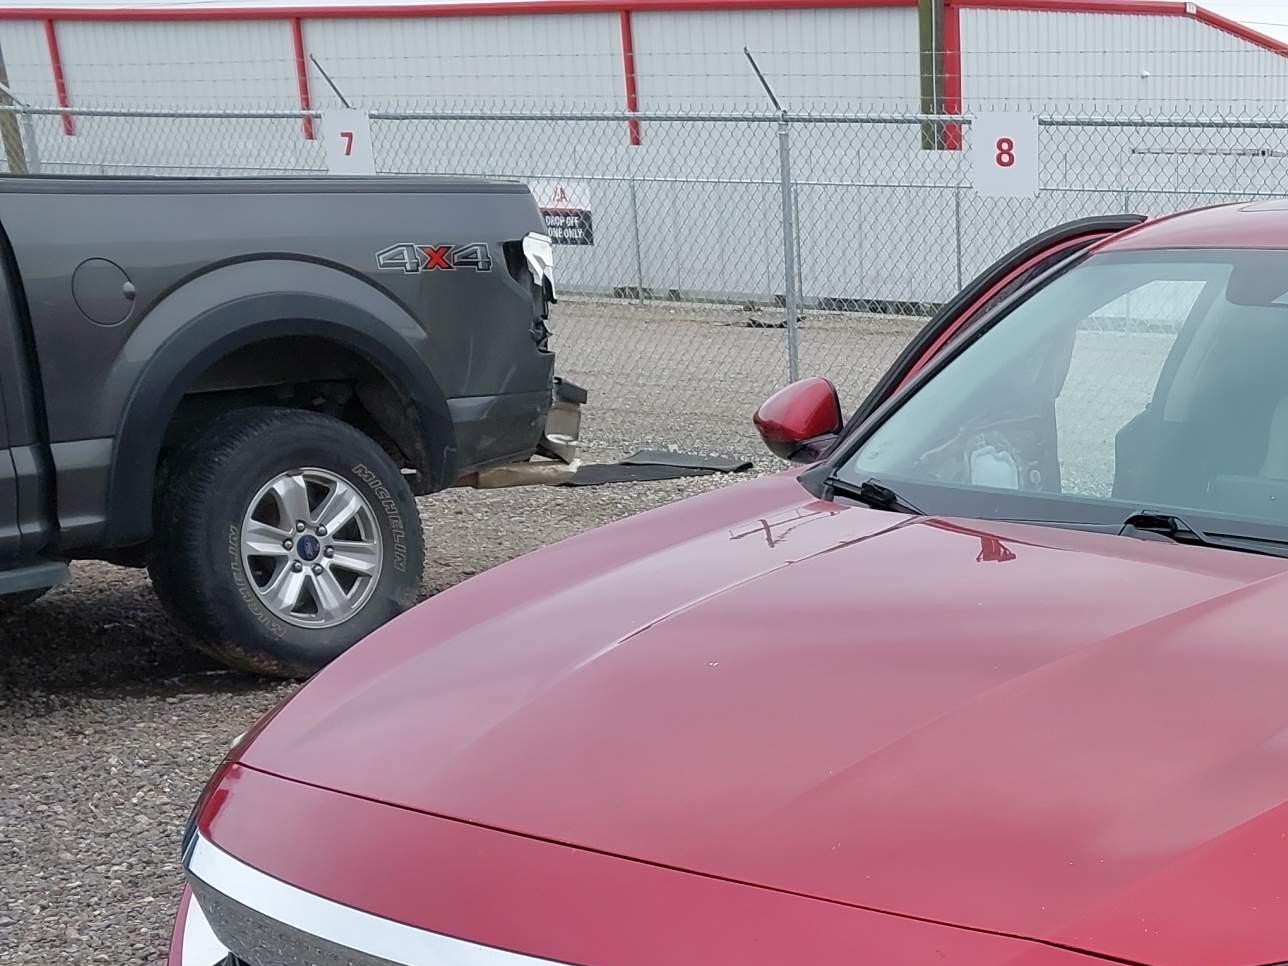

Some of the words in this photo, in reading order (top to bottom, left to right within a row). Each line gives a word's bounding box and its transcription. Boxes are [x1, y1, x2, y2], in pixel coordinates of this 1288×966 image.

[340, 132, 353, 156] 7
[996, 137, 1015, 167] 8
[545, 215, 565, 227] DROP
[566, 216, 580, 228] OFF
[547, 228, 563, 238] ONE
[564, 228, 584, 239] ONLY
[352, 463, 407, 573] MICHELIN
